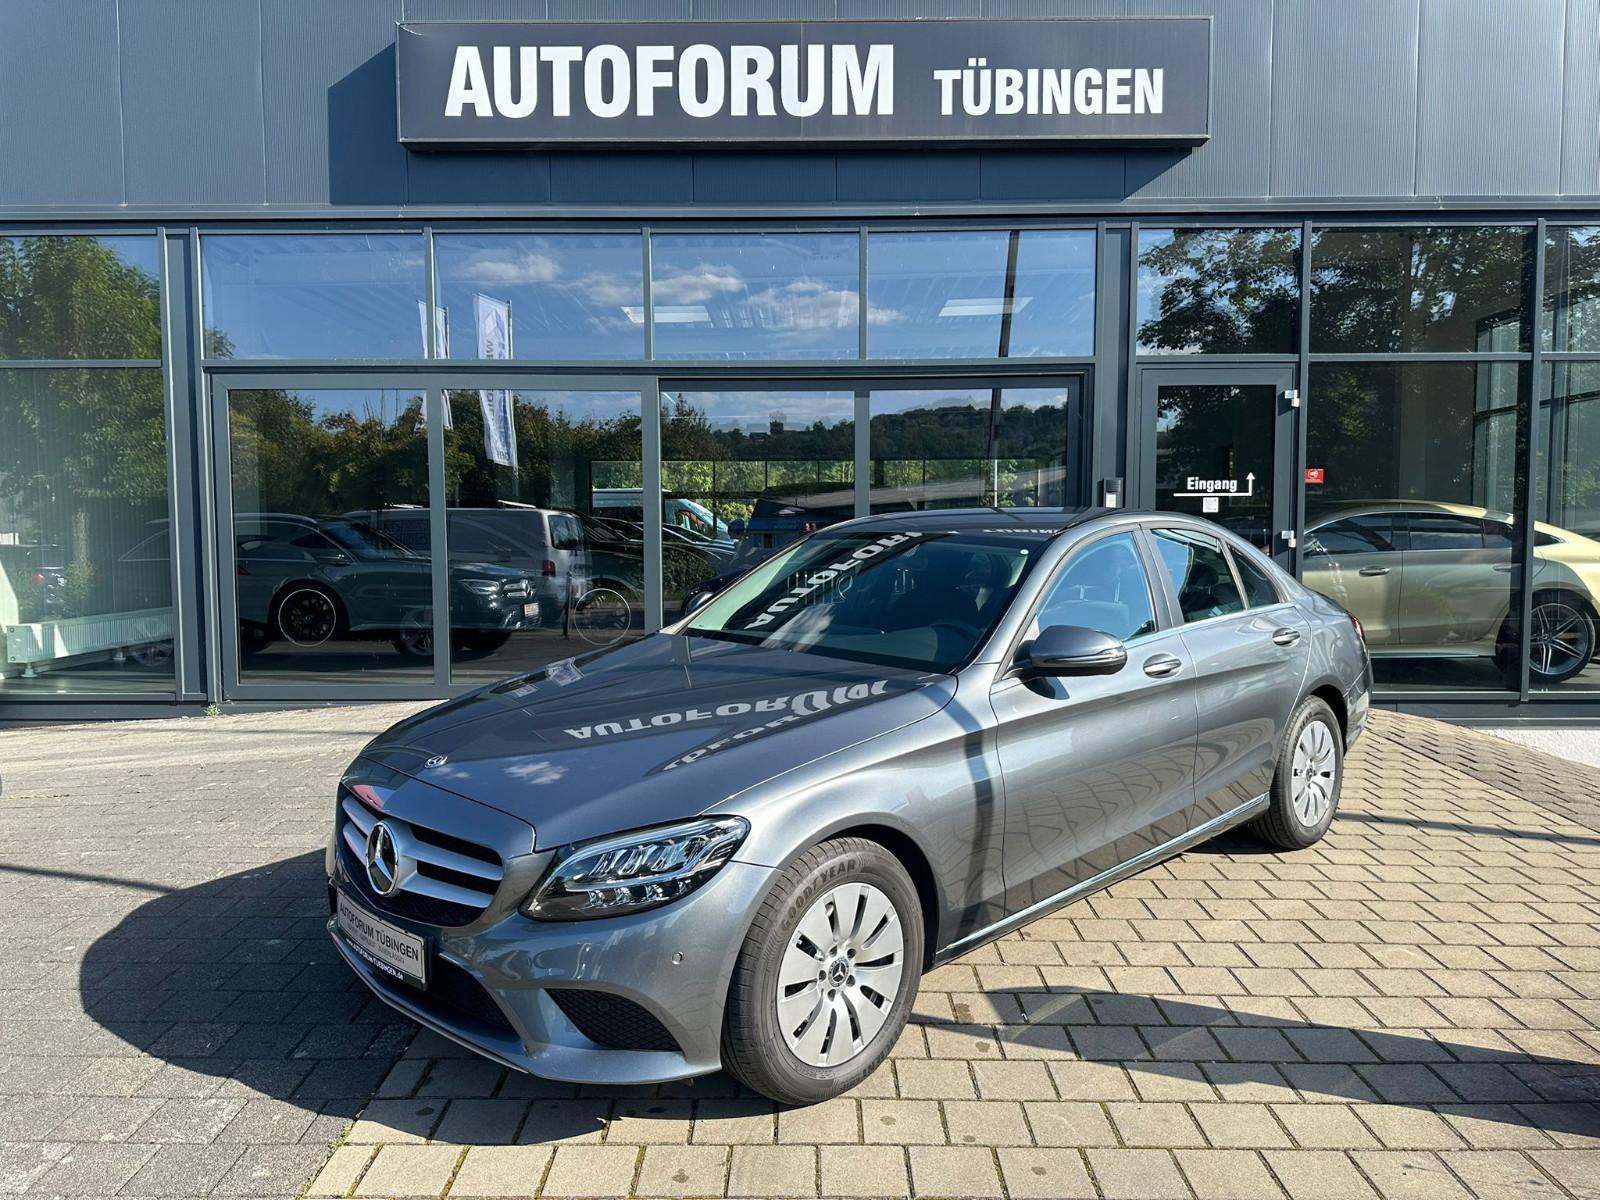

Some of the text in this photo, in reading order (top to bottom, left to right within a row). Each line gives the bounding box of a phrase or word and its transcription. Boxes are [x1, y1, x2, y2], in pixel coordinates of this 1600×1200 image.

[445, 44, 1163, 118] AUTOFORUM TÜBINGEN
[1186, 476, 1238, 493] Eingang
[781, 860, 856, 931] GOODYEAR
[340, 902, 374, 939] AUTOFORUM
[375, 929, 419, 961] TÜBINGEN
